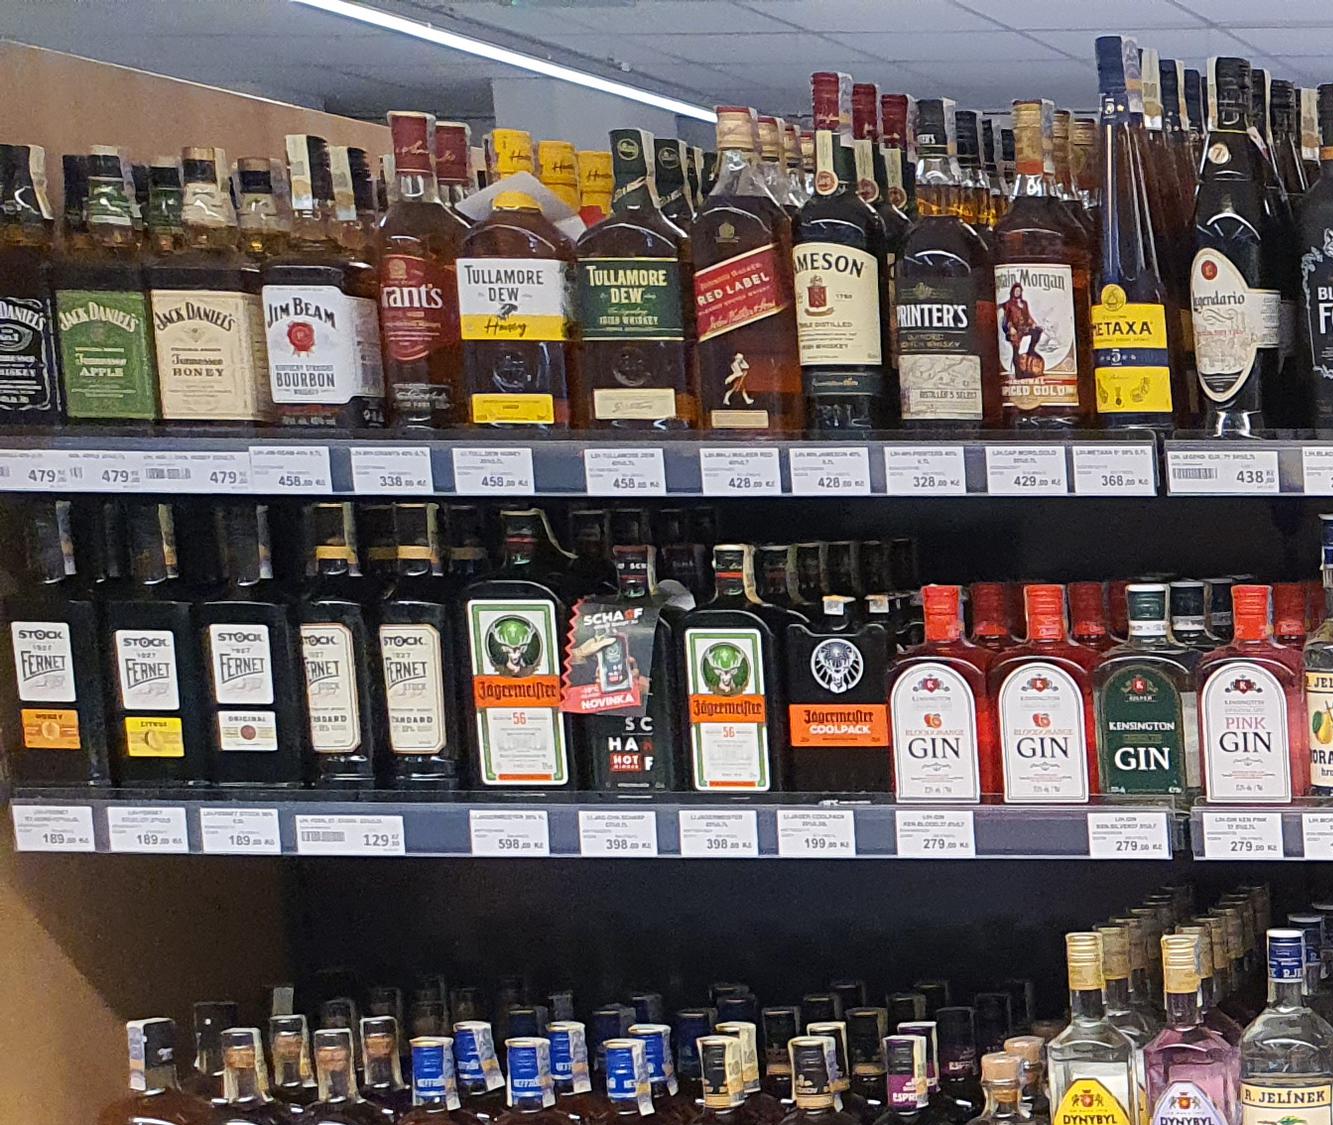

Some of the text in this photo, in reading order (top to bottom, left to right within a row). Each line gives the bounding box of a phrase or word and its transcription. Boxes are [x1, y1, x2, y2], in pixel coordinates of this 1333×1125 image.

[464, 264, 544, 286] TULLAMORE
[585, 265, 667, 287] TULLAMORE
[1018, 270, 1066, 291] Morgan
[488, 286, 518, 302] DEW
[610, 287, 643, 304] DEW
[696, 272, 770, 305] RED LABEL
[59, 302, 139, 332] JACK DANIEL'S
[155, 302, 236, 331] JACK DANIEL'S
[267, 297, 337, 328] JIM BEAM
[896, 305, 968, 329] PRINTER'S
[80, 368, 124, 377] APPLE
[173, 368, 224, 377] HONEY
[276, 372, 335, 387] BOURBON
[28, 469, 56, 482] 479
[102, 470, 129, 482] 479
[1236, 470, 1264, 484] 438
[19, 629, 63, 640] STOCK
[123, 637, 168, 648] STOCK
[21, 651, 66, 680] FERNET
[126, 658, 170, 687] FERNET
[220, 652, 264, 683] FERNET
[478, 679, 557, 702] Jägermeister
[580, 693, 634, 710] NOVINKA
[693, 697, 762, 718] Jägermeister
[512, 712, 526, 725] 56
[804, 709, 874, 724] Jägermeister
[1225, 717, 1266, 730] PINK
[809, 724, 870, 735] COOLPACK
[1109, 721, 1175, 732] KENSINGTON
[908, 738, 961, 759] GIN
[1016, 737, 1069, 759] GIN
[1219, 731, 1272, 754] GIN
[1114, 747, 1170, 771] GIN
[363, 834, 389, 846] 129
[1063, 1114, 1118, 1125] DYNYBYL
